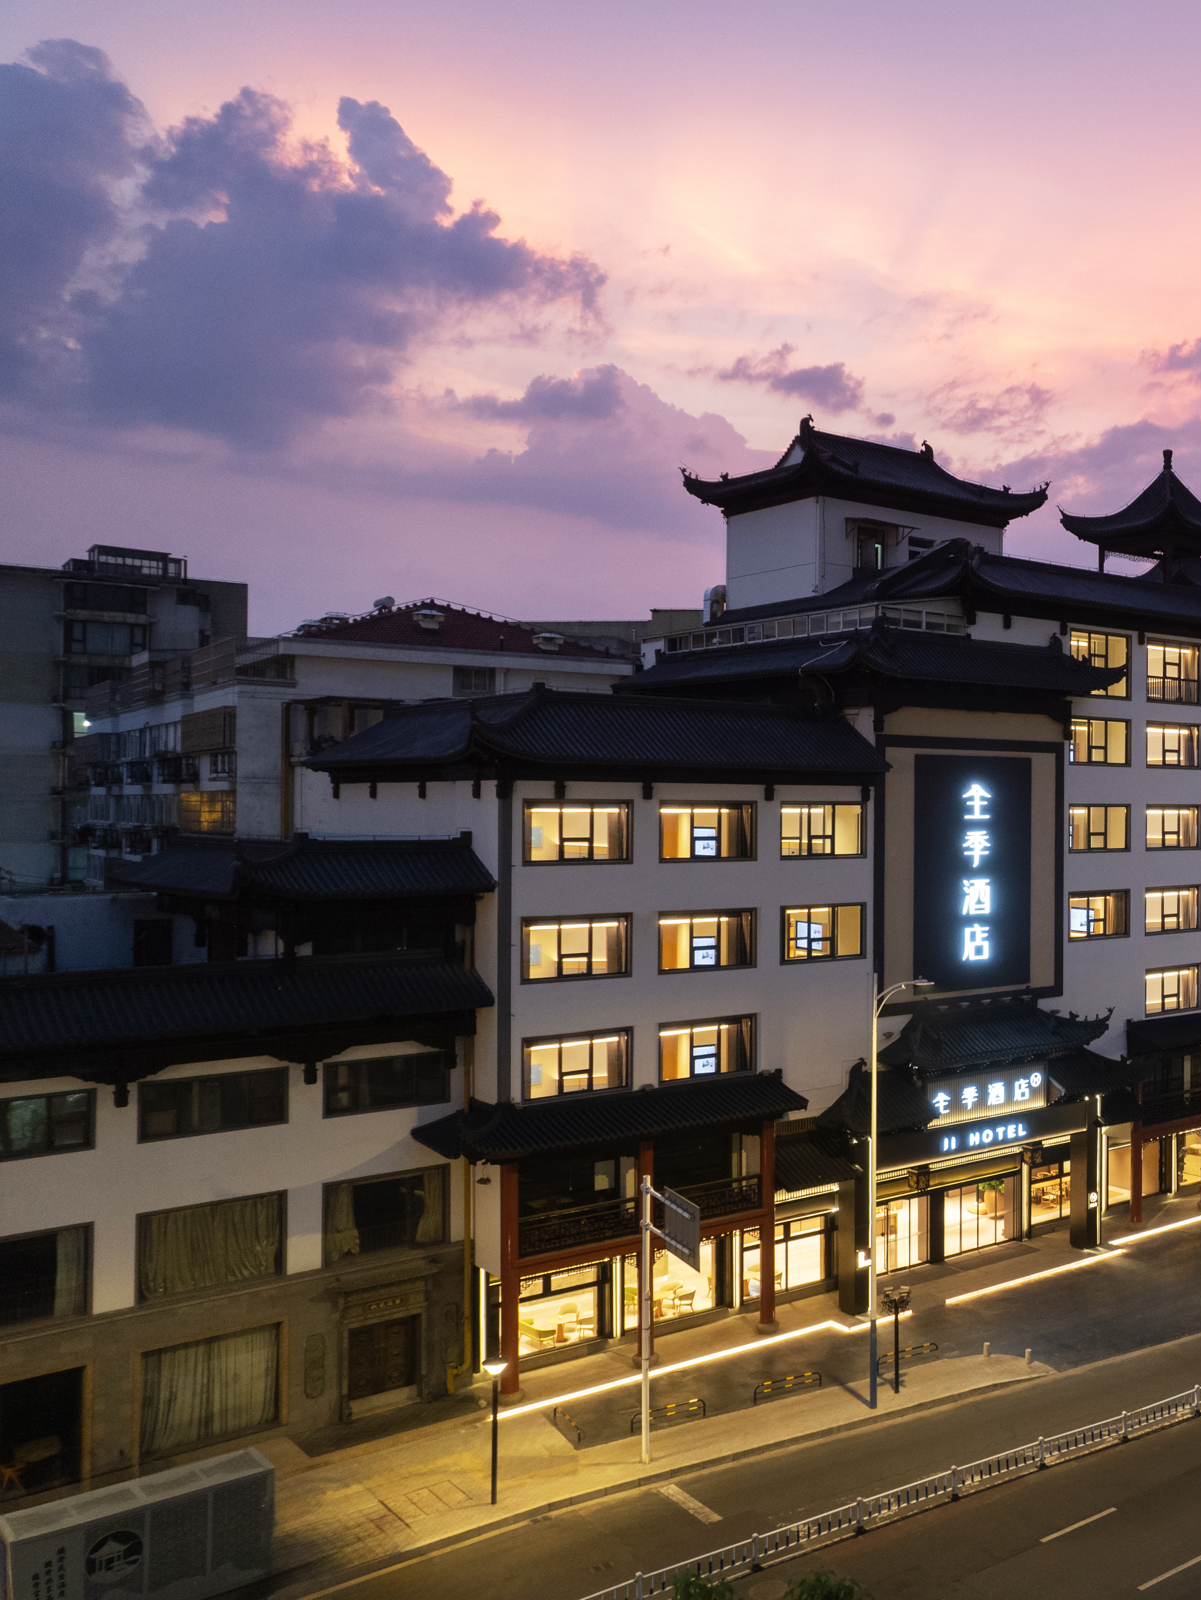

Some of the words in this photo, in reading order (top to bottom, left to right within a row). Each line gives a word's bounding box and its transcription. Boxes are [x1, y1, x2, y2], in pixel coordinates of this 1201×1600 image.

[962, 784, 992, 961] 全季酒店
[932, 1078, 1030, 1115] 全季酒店
[969, 1123, 1027, 1147] HOTEL
